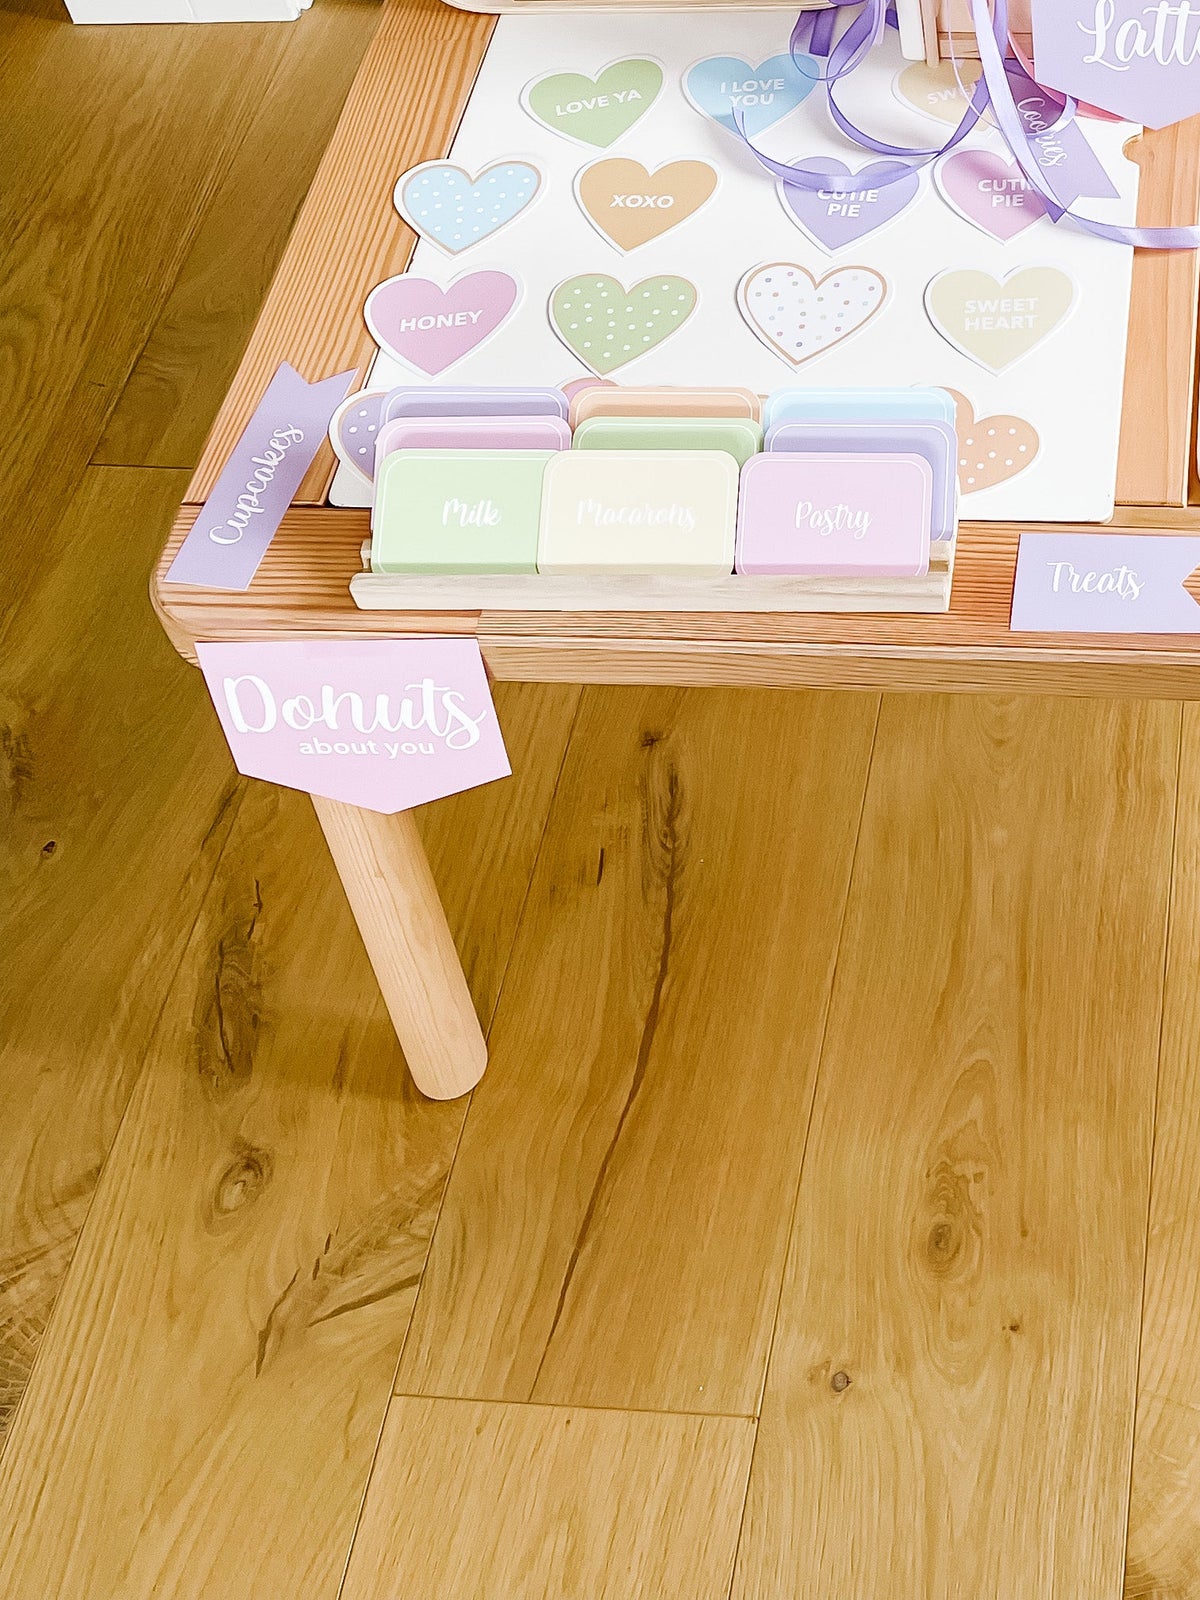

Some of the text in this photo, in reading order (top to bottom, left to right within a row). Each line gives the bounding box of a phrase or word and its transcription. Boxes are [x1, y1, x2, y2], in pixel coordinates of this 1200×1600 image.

[719, 78, 785, 94] I LOVE
[554, 88, 643, 116] LOVE YA
[729, 93, 776, 108] YOU
[977, 178, 1034, 193] CUTI
[609, 193, 674, 209] XOXO
[826, 203, 861, 218] PIE
[991, 194, 1024, 208] PIE
[964, 297, 1039, 315] SWEET
[398, 309, 483, 333] HONEY
[963, 313, 1038, 332] HEART
[209, 423, 304, 546] Cupcakes
[441, 499, 503, 528] Milk
[575, 499, 697, 533] Macarons
[794, 501, 872, 540] Pastry
[1047, 561, 1145, 600] Treats
[222, 675, 488, 750] Donuts
[298, 737, 436, 759] about you
